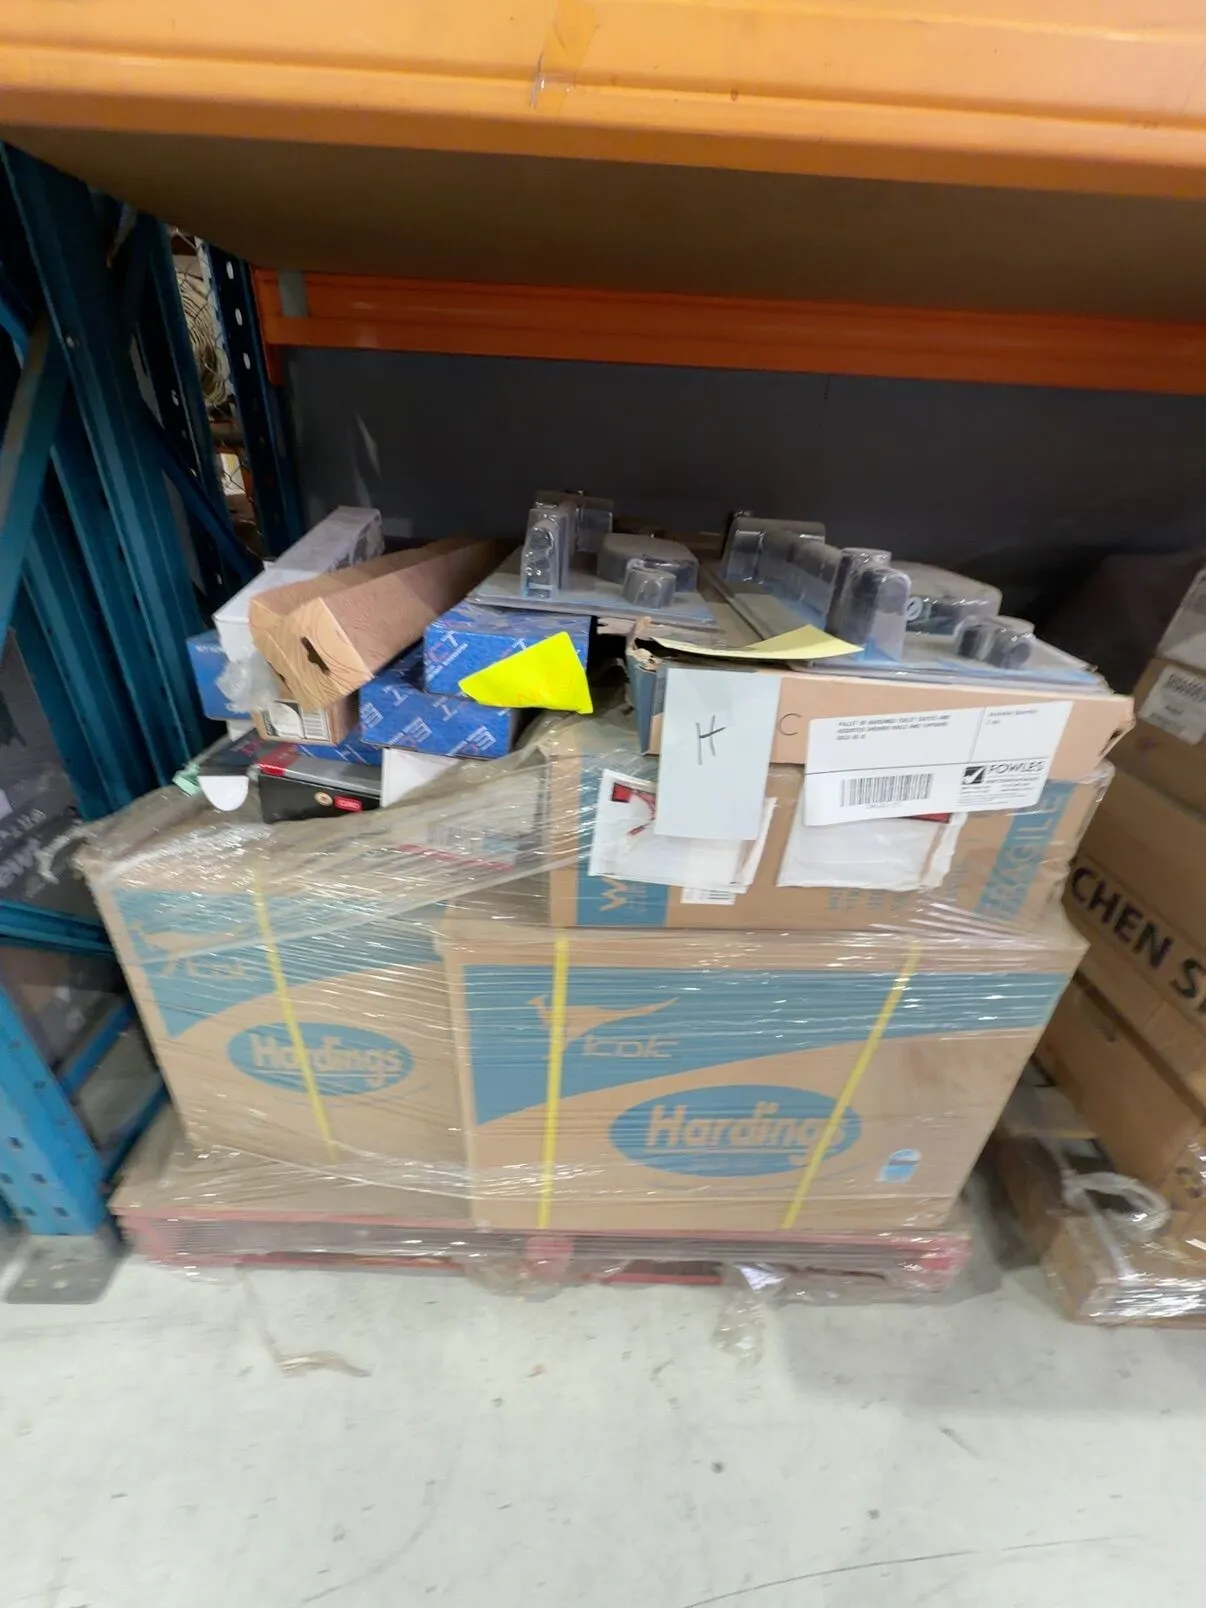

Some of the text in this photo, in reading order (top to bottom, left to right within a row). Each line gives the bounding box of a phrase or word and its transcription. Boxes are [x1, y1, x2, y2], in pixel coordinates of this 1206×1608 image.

[695, 714, 728, 765] H
[988, 761, 1046, 775] FOWLES
[1071, 865, 1175, 971] CHEN
[646, 1100, 848, 1166] Hardings
